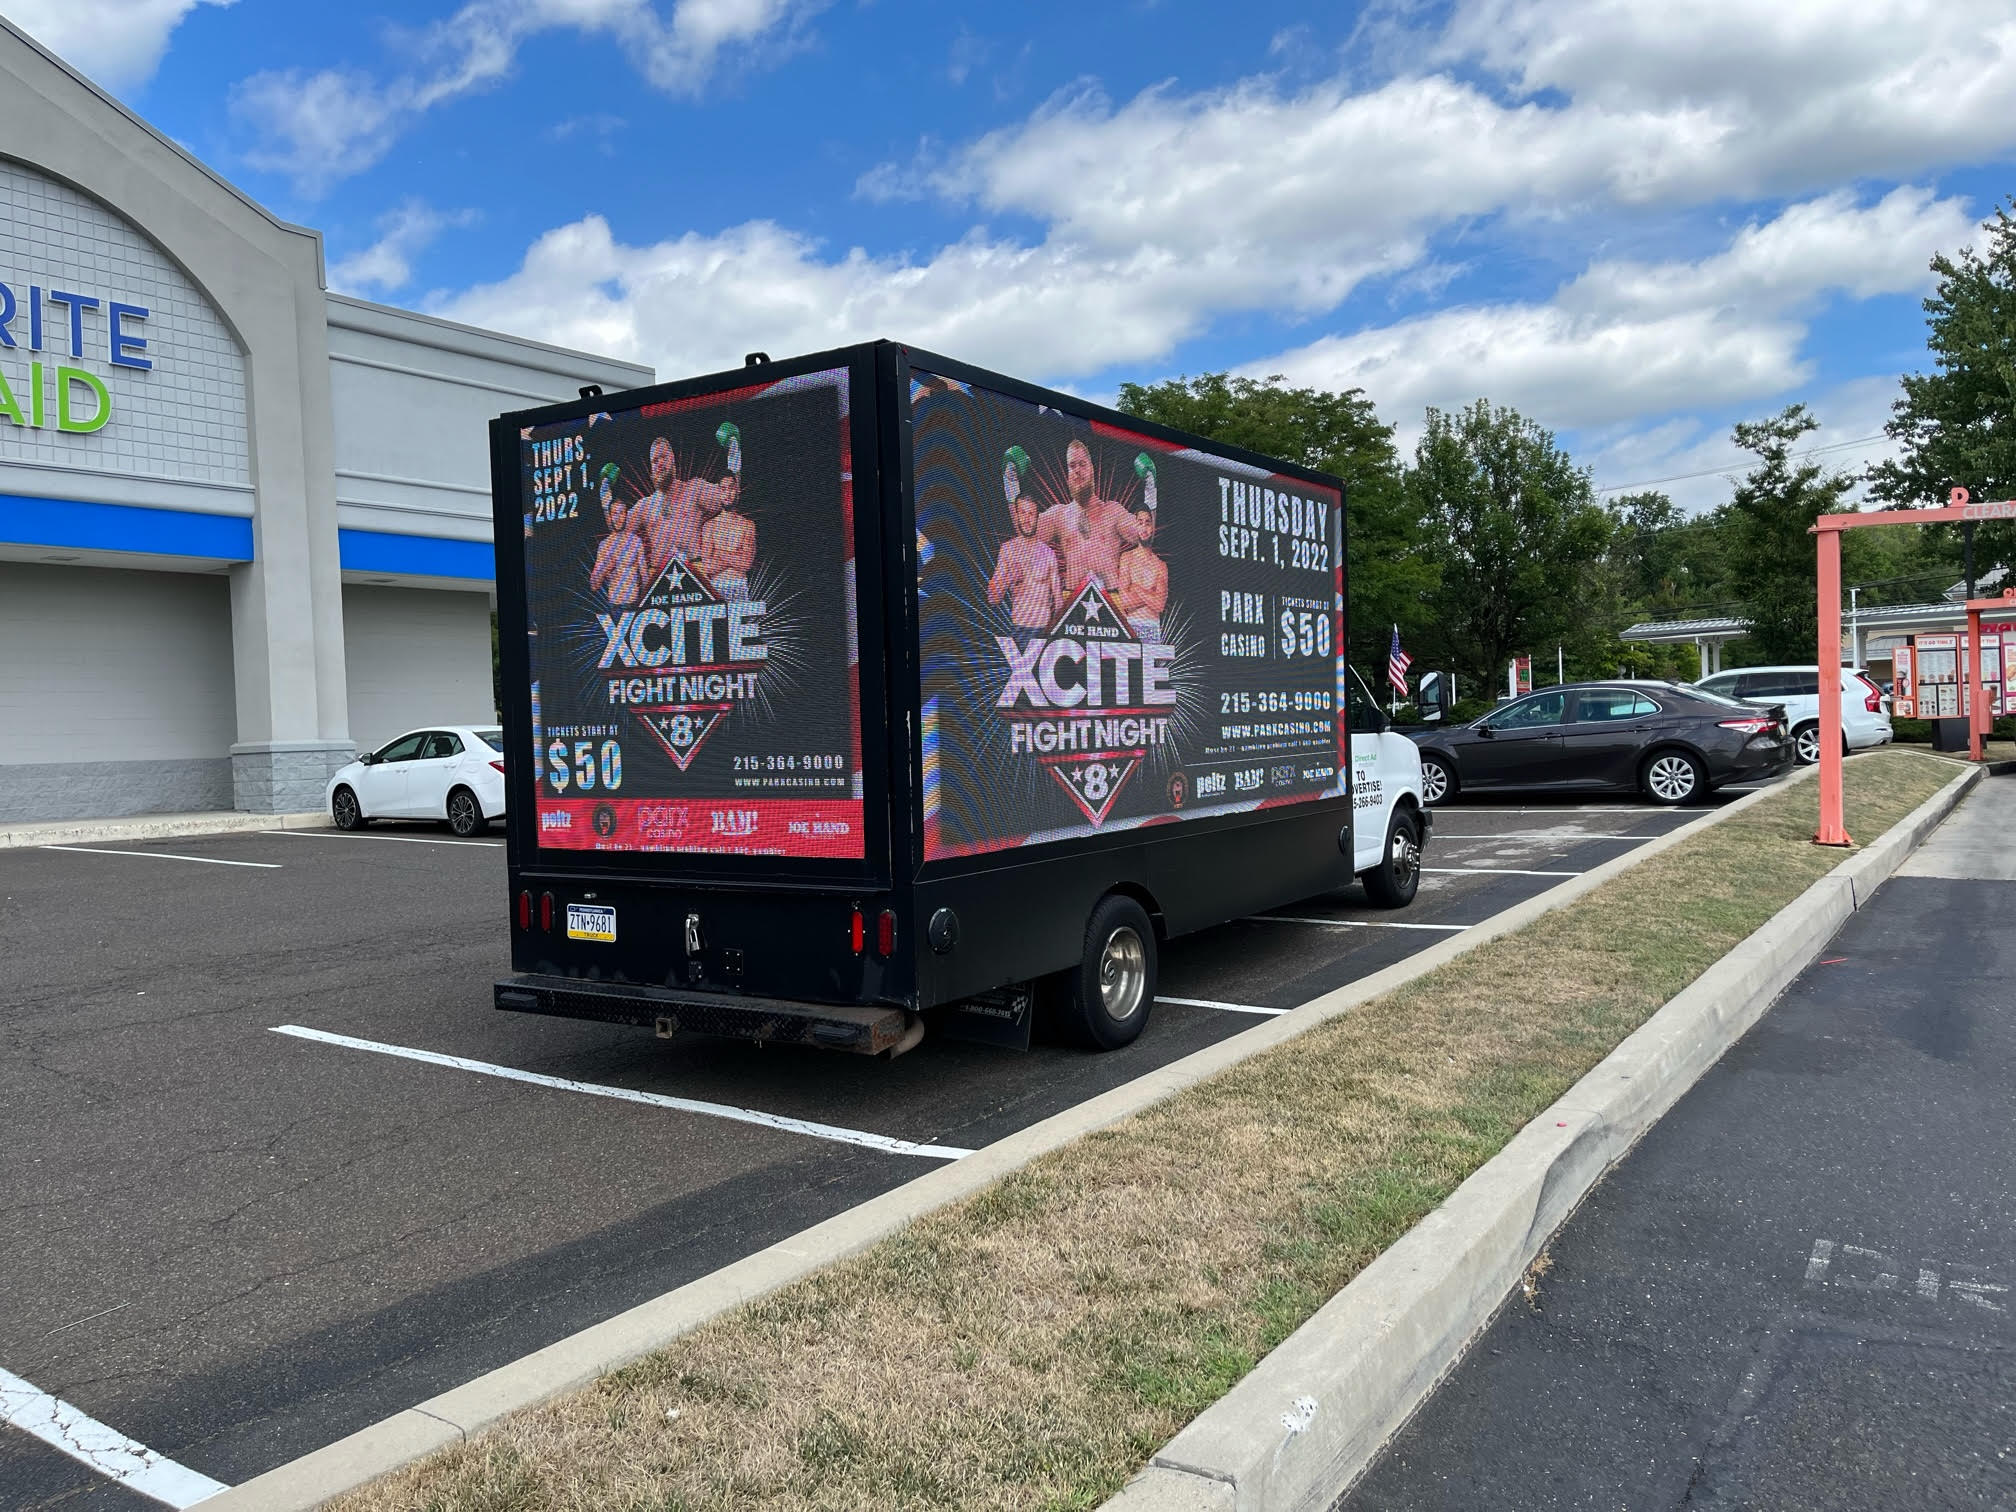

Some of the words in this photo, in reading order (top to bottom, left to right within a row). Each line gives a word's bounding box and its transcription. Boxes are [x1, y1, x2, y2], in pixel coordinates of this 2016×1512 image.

[532, 435, 591, 468] THURS.
[533, 465, 573, 495] SEPT
[580, 462, 595, 490] 1,
[535, 491, 579, 522] 2022
[1218, 476, 1328, 542] THURSDAY
[1962, 504, 2016, 520] CLEAR
[1219, 524, 1265, 563] SEPT.
[1291, 538, 1329, 573] 2022
[595, 600, 769, 669] XCITE
[1064, 625, 1085, 636] JOE
[1087, 626, 1120, 637] HAND
[1221, 632, 1265, 658] CASINO
[1281, 607, 1331, 659] $50
[994, 636, 1177, 708] XCITE
[1220, 691, 1331, 713] 215-364-9000
[670, 714, 694, 747] 8
[548, 738, 622, 794] $50
[733, 755, 844, 770] 215-364-9000
[1356, 770, 1366, 781] TO
[1083, 762, 1109, 801] 8
[1352, 780, 1382, 795] DVERTISE!
[1353, 793, 1383, 809] 5-266-9403
